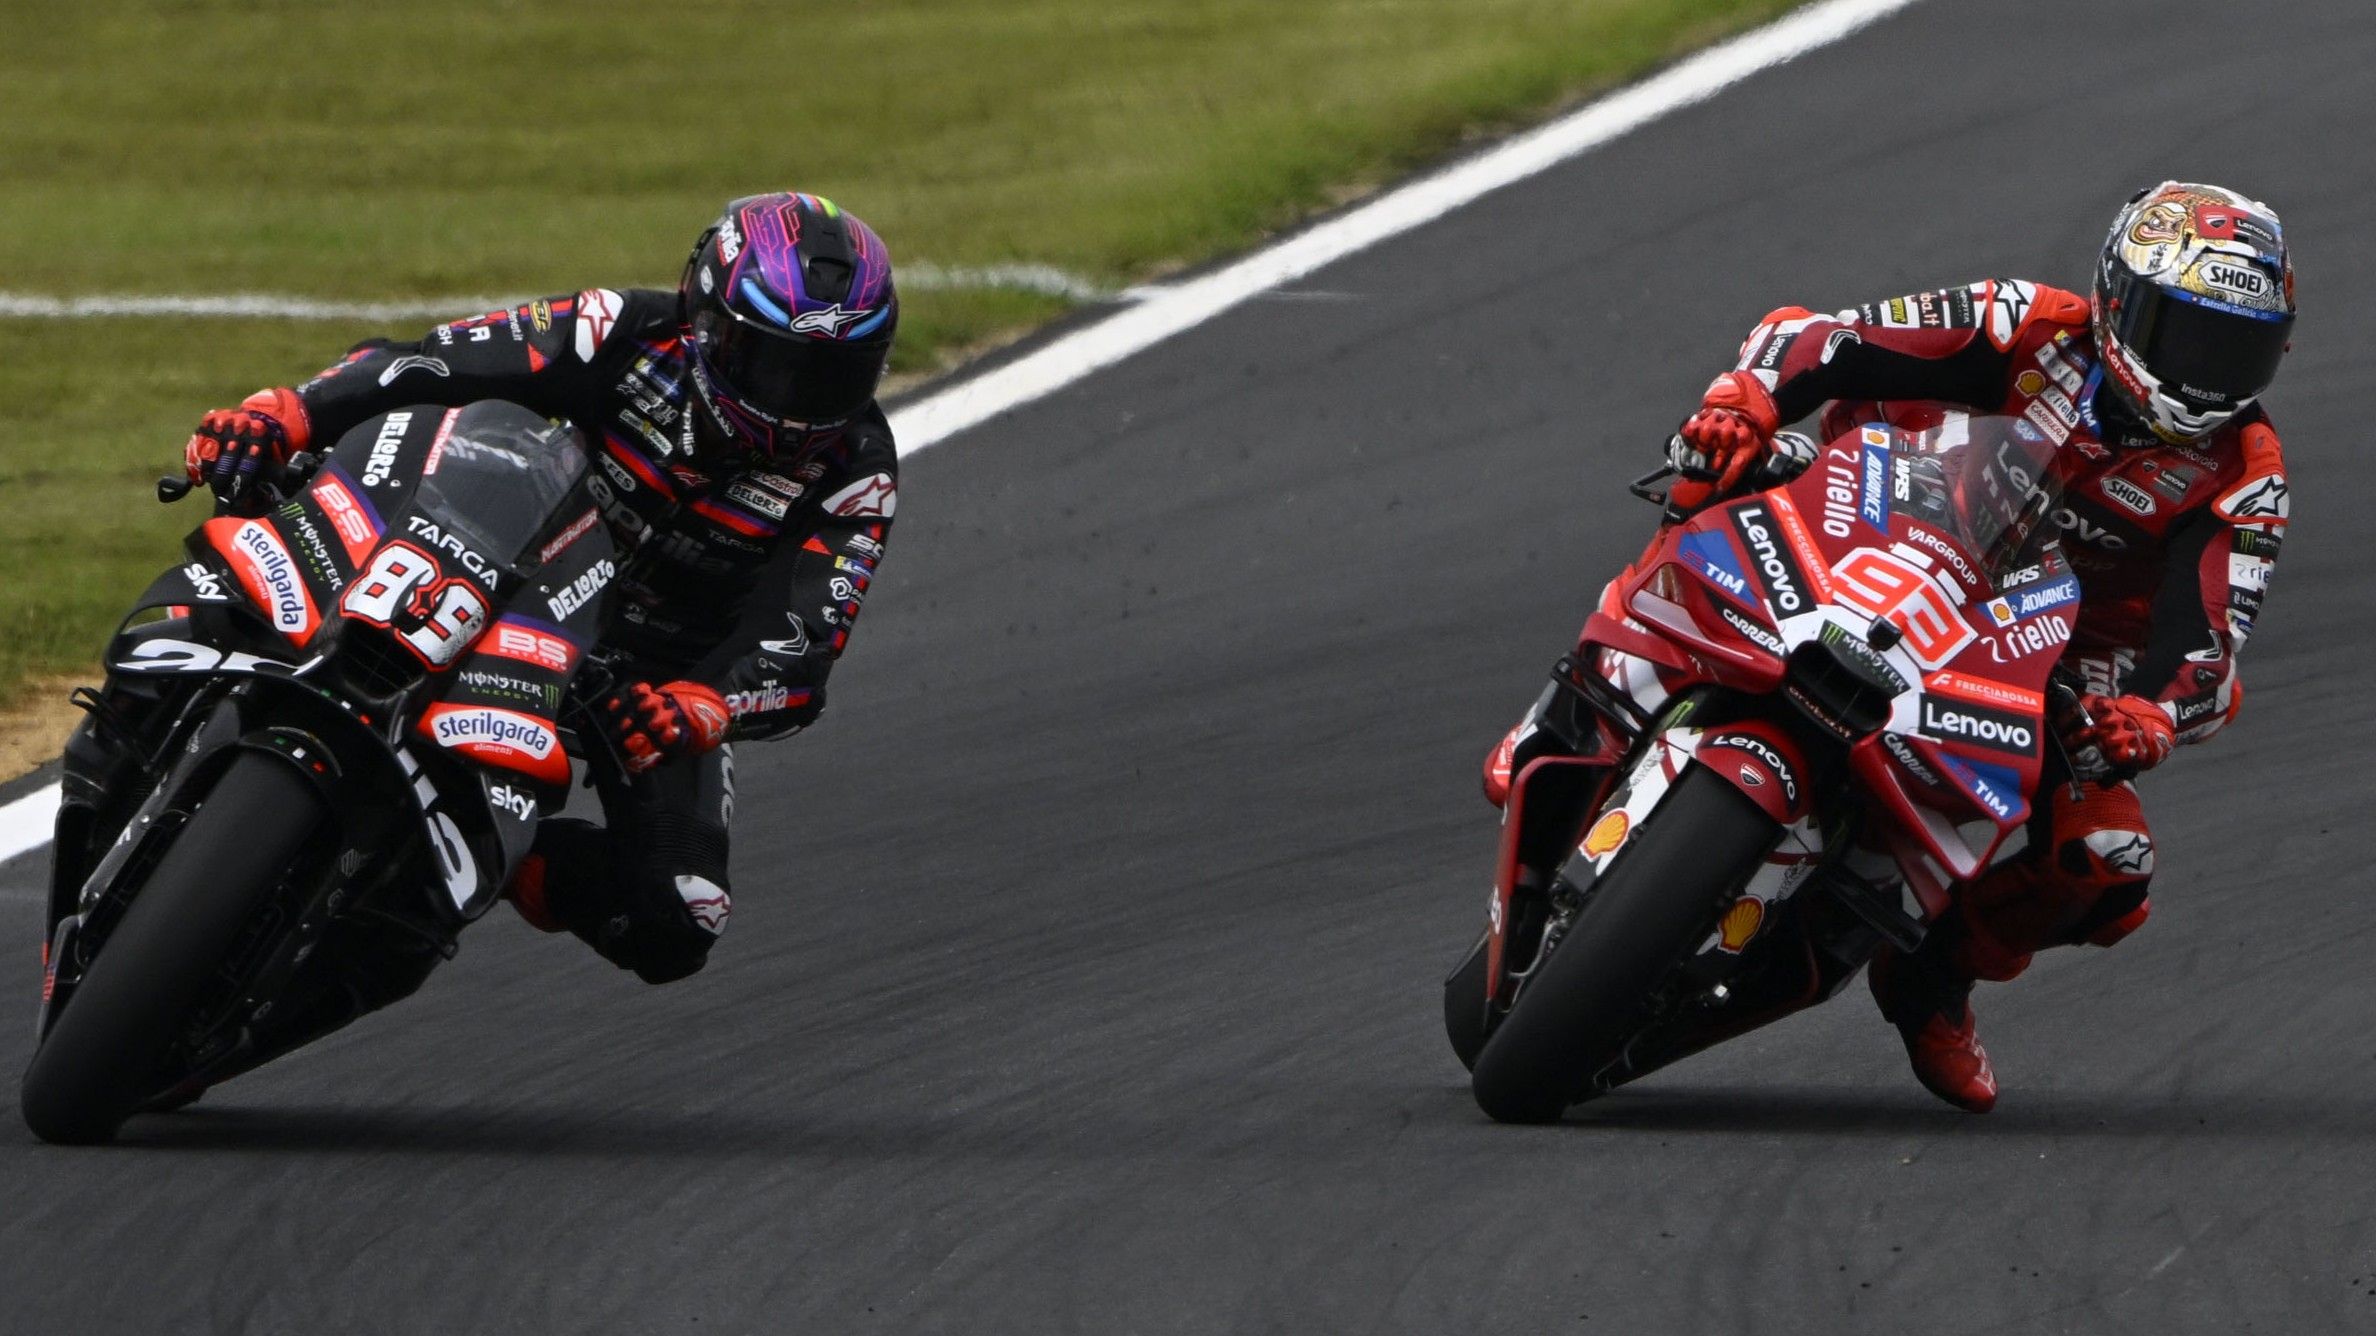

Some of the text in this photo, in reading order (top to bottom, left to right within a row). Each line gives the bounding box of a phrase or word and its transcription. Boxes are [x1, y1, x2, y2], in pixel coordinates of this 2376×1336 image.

[2236, 219, 2273, 242] Lenovo
[2210, 265, 2262, 293] SHOEI
[2200, 297, 2231, 312] Estrella
[2231, 305, 2257, 318] Galicia
[1761, 333, 1791, 366] Lenovo
[2106, 345, 2142, 395] Lenovo
[2181, 383, 2226, 402] Insta360
[2030, 404, 2067, 441] CARRERA
[2080, 398, 2097, 428] TIM
[1865, 451, 1884, 523] ADVANCE
[1895, 457, 1910, 501] WRS
[2107, 479, 2149, 513] SHOEI
[2161, 471, 2186, 489] Lenovo
[318, 483, 371, 543] BS
[1823, 465, 1859, 538] riello
[296, 516, 343, 591] MONSTER
[408, 516, 499, 592] TARGA
[1738, 508, 1800, 610] Lenovo
[1787, 517, 1832, 594] FRECCIAROSSA
[183, 563, 228, 600] sky
[241, 526, 299, 626] sterilgarda
[1706, 563, 1745, 594] TIM
[2003, 565, 2040, 588] WRS
[340, 540, 491, 673] 89
[1831, 548, 1977, 670] 93
[2021, 581, 2074, 613] ADVANCE
[499, 628, 567, 664] BS
[1722, 608, 1786, 656] CARRERA
[2006, 615, 2070, 659] riello
[458, 671, 542, 697] MONSTER
[726, 680, 788, 716] aprilia
[1955, 679, 2038, 707] FRECCIAROSSA
[1926, 702, 2032, 748] Lenovo
[2180, 697, 2215, 720] Lenovo
[439, 712, 548, 752] sterilgarda
[1713, 735, 1795, 800] Lenovo
[1883, 733, 1939, 786] CARRERA
[490, 785, 536, 821] sky
[1975, 780, 2010, 817] TIM
